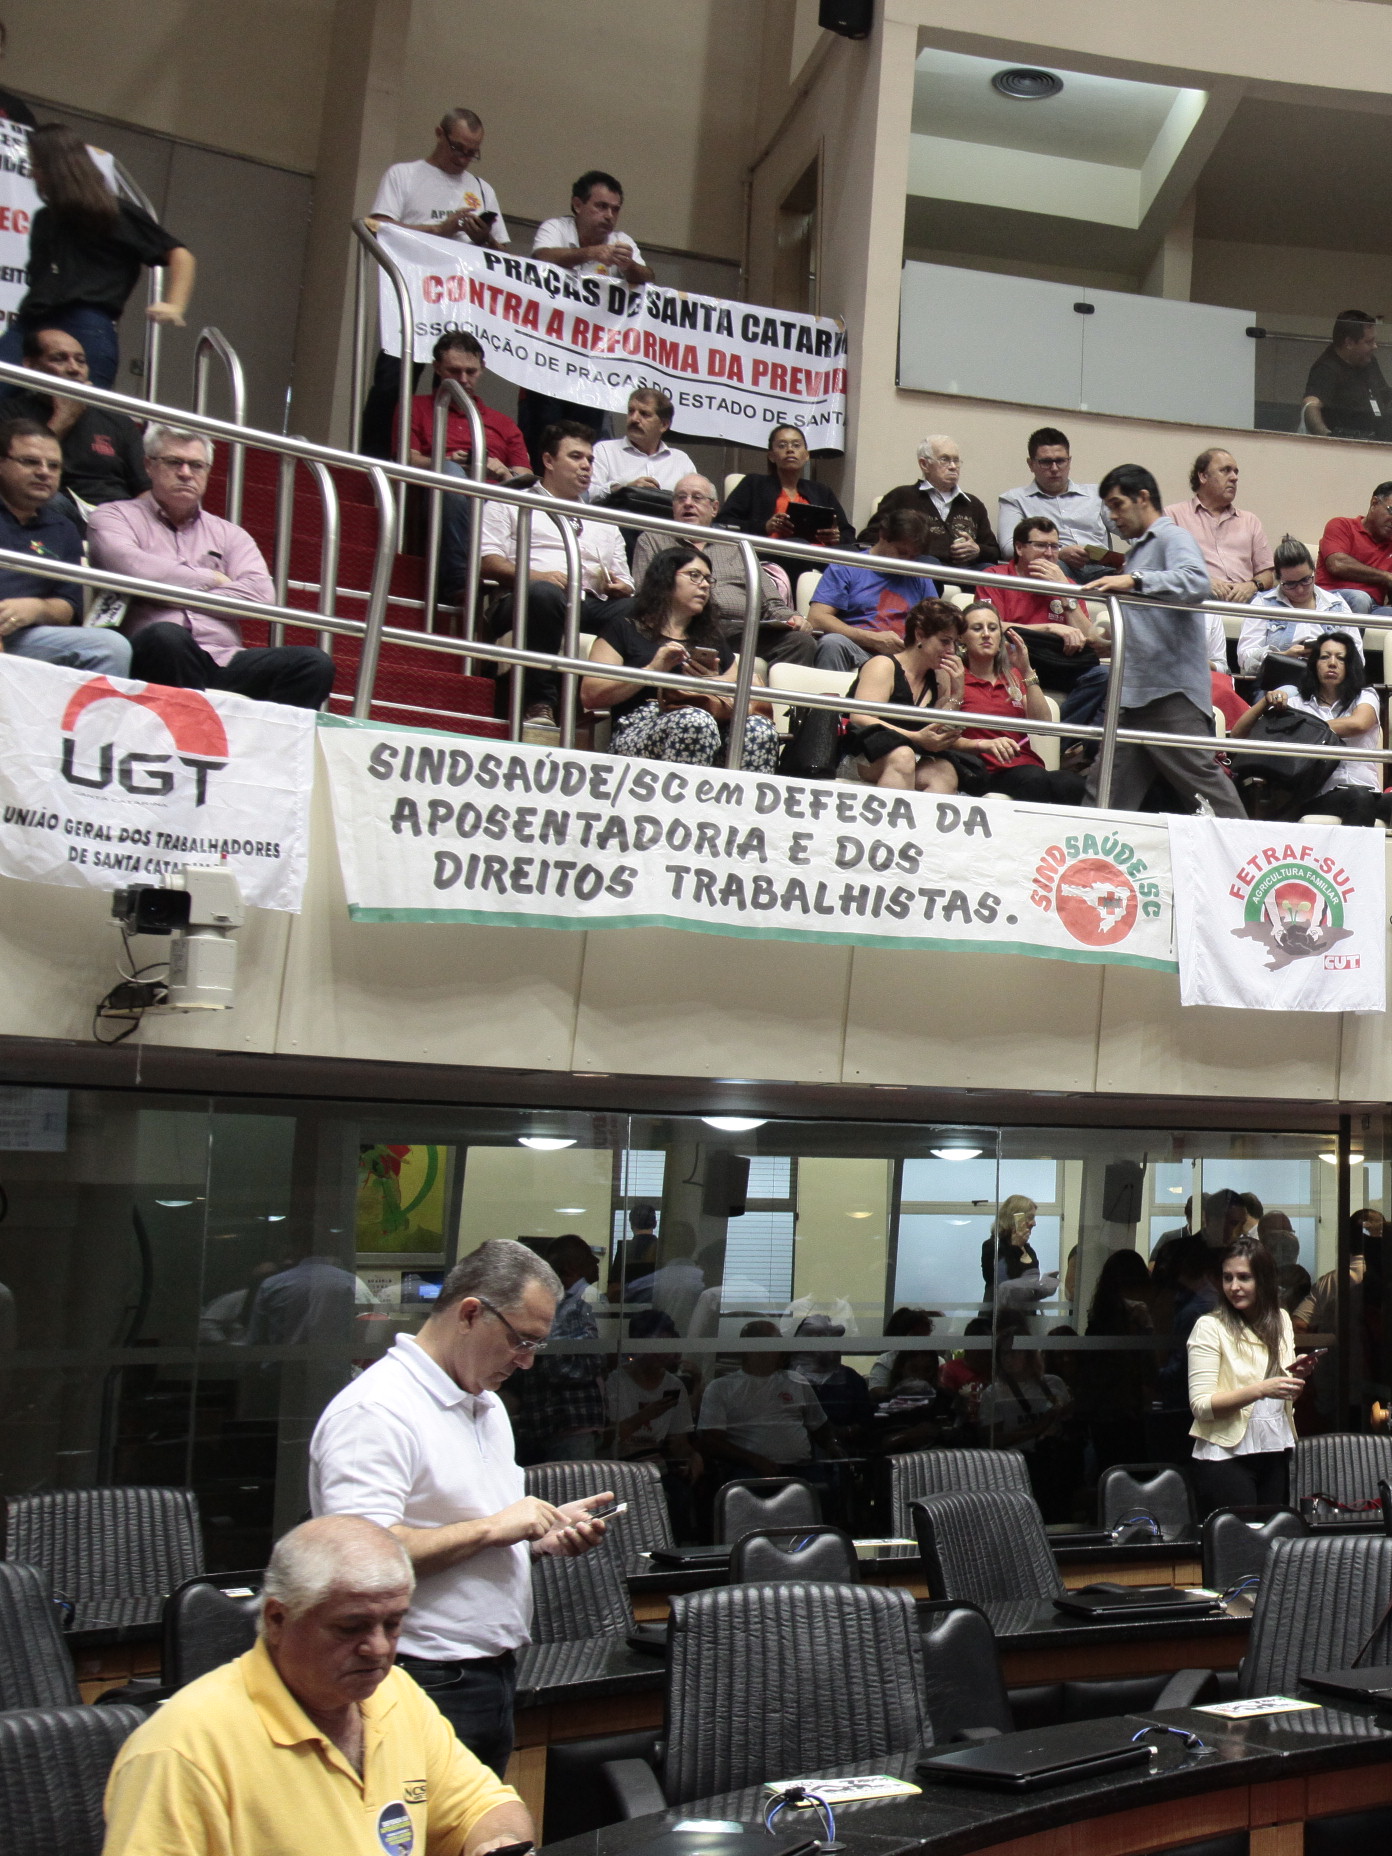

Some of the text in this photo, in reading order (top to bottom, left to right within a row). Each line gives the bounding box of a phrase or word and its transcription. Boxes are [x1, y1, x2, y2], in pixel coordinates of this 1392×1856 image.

[422, 274, 540, 332] CONTRA
[545, 308, 565, 341] A
[571, 316, 699, 375] REFORMA
[707, 348, 745, 384] DA
[483, 250, 600, 307] PRAÇAS
[646, 289, 734, 338] SANTA
[399, 321, 529, 361] SSOCIAÇÃO
[535, 353, 560, 372] DE
[679, 392, 757, 418] ESTADO
[763, 408, 787, 425] DE
[794, 411, 846, 428] SANT
[61, 736, 229, 808] UGT
[367, 742, 993, 839] SINDSAÚDE/SC em DEFESA DA
[3, 805, 281, 859] UNIÃO GERAL DOS TRABALHADORES
[68, 845, 88, 864] DE
[92, 850, 141, 873] SANTA
[390, 797, 924, 875] APOSENTADORIA E DOS
[433, 850, 1019, 926] DIREITOS TRABALHISTAS.
[1229, 843, 1355, 903] FETRAF-SUL
[1252, 866, 1340, 906] AGRICULTURA FAMILIAR
